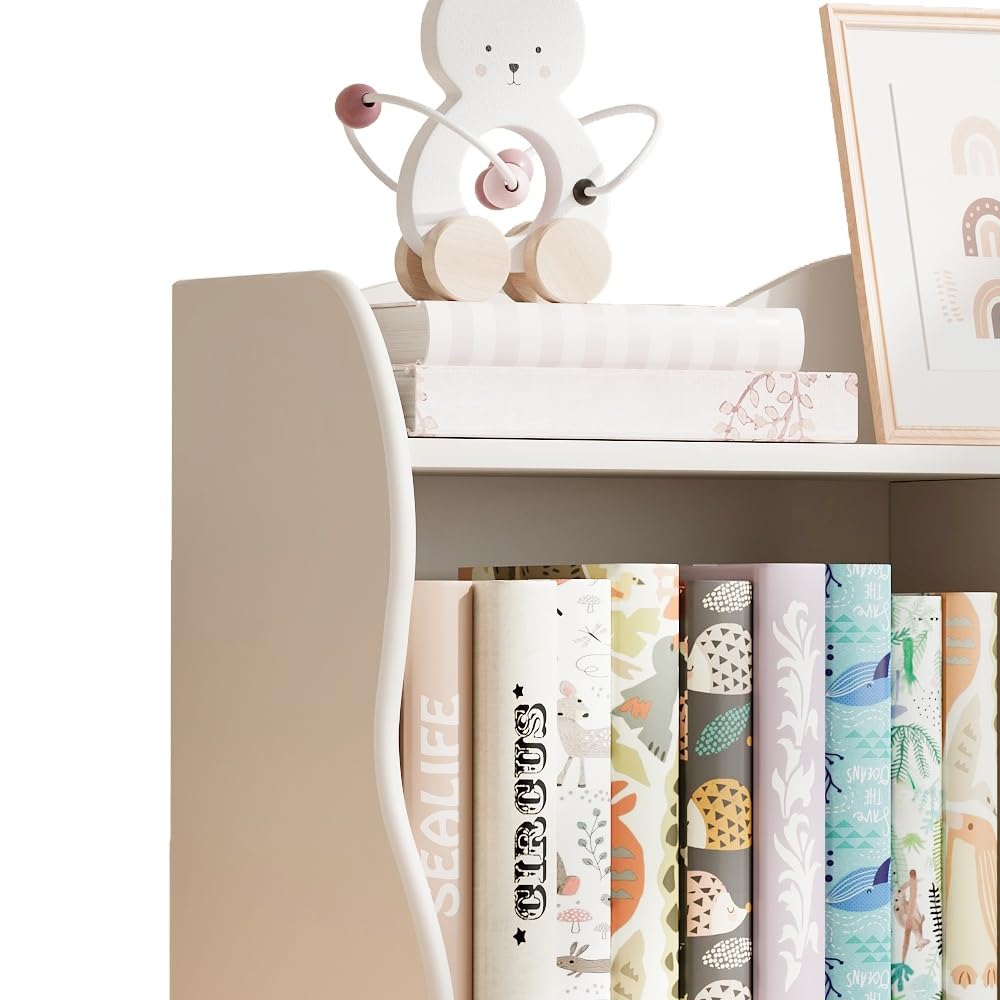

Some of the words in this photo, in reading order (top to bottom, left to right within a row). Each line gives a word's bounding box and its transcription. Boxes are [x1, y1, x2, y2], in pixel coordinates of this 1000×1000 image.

[863, 582, 882, 600] THE
[419, 695, 461, 918] SEALIFE
[514, 703, 547, 921] CIRCUS
[863, 788, 882, 806] THE
